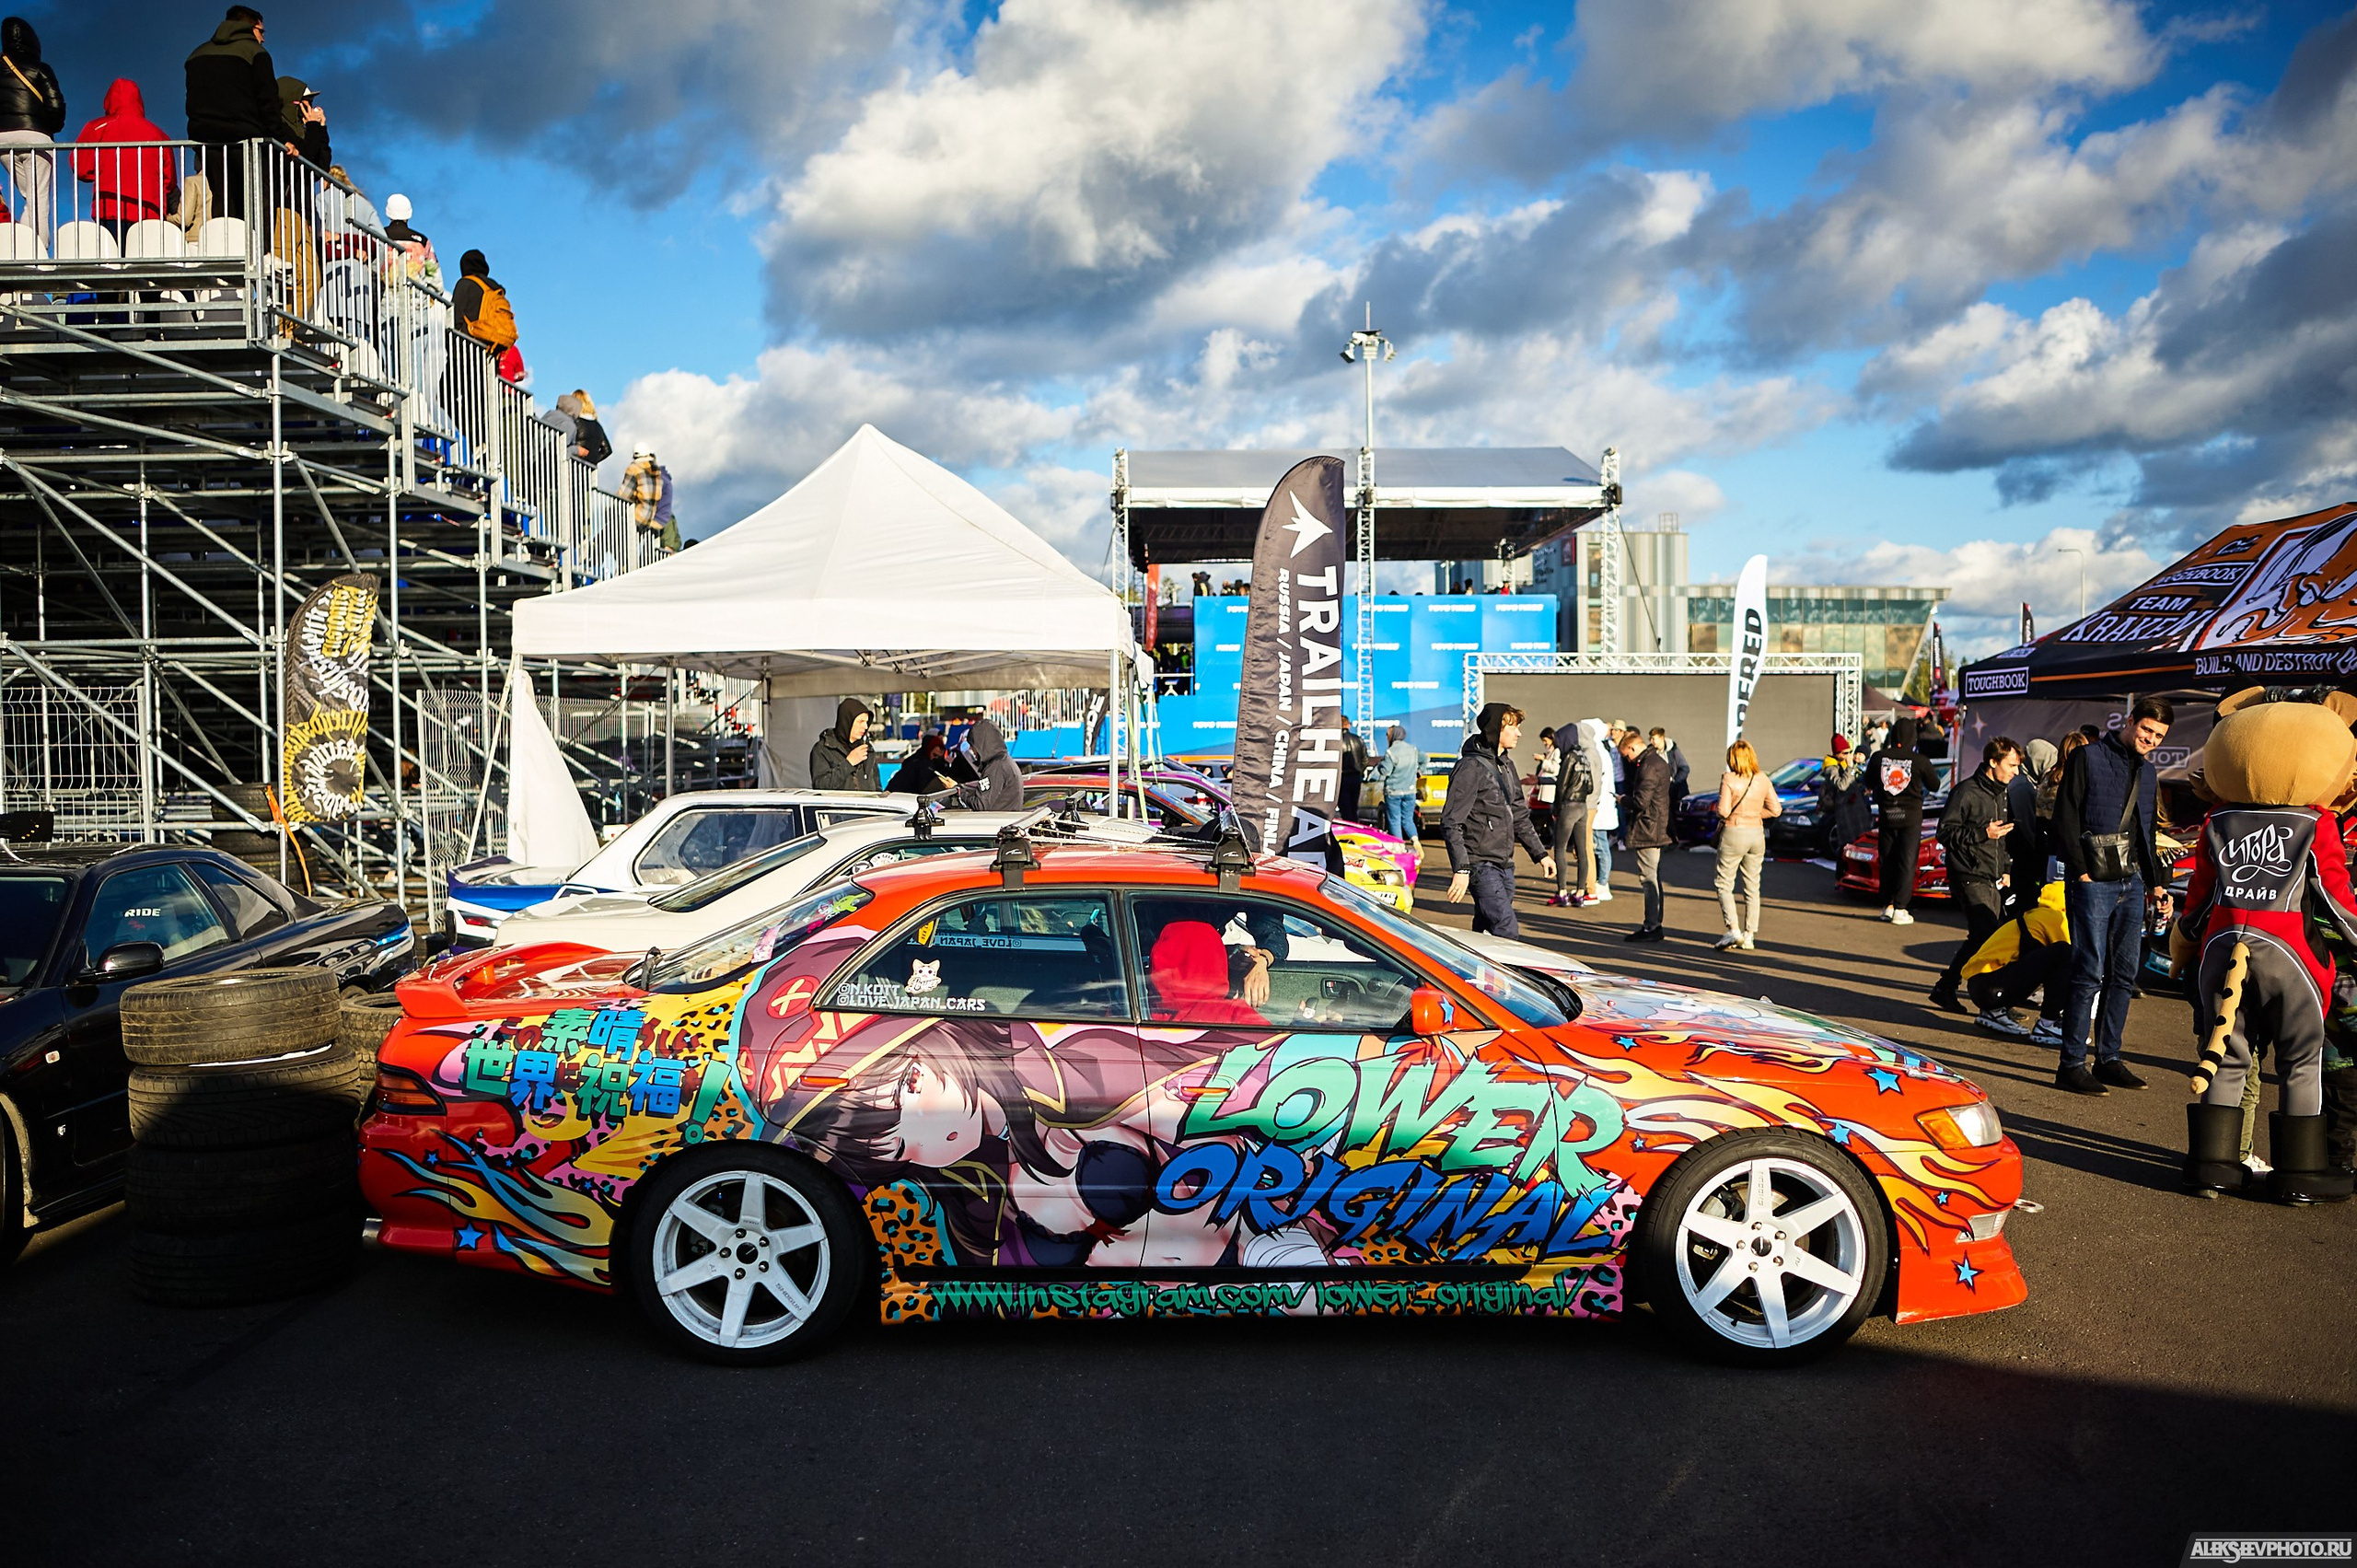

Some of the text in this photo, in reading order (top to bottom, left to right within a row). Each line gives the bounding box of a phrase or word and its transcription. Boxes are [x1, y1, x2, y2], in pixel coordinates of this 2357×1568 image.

[1278, 567, 1291, 634] RUSSIA
[2129, 597, 2193, 610] TEAM
[2061, 609, 2215, 642] KRAKEN
[1278, 651, 1293, 712] JAPAN
[1968, 672, 2026, 691] TOUGHBOOK
[2195, 655, 2233, 675] BUILD
[2235, 653, 2263, 672] AND
[2265, 652, 2340, 671] DESTROY
[1269, 729, 1290, 789] CHINA
[2223, 886, 2277, 900] ДРАЙВ
[1182, 1043, 1624, 1200] LOWER
[1157, 1143, 1628, 1268] ORIGINAL
